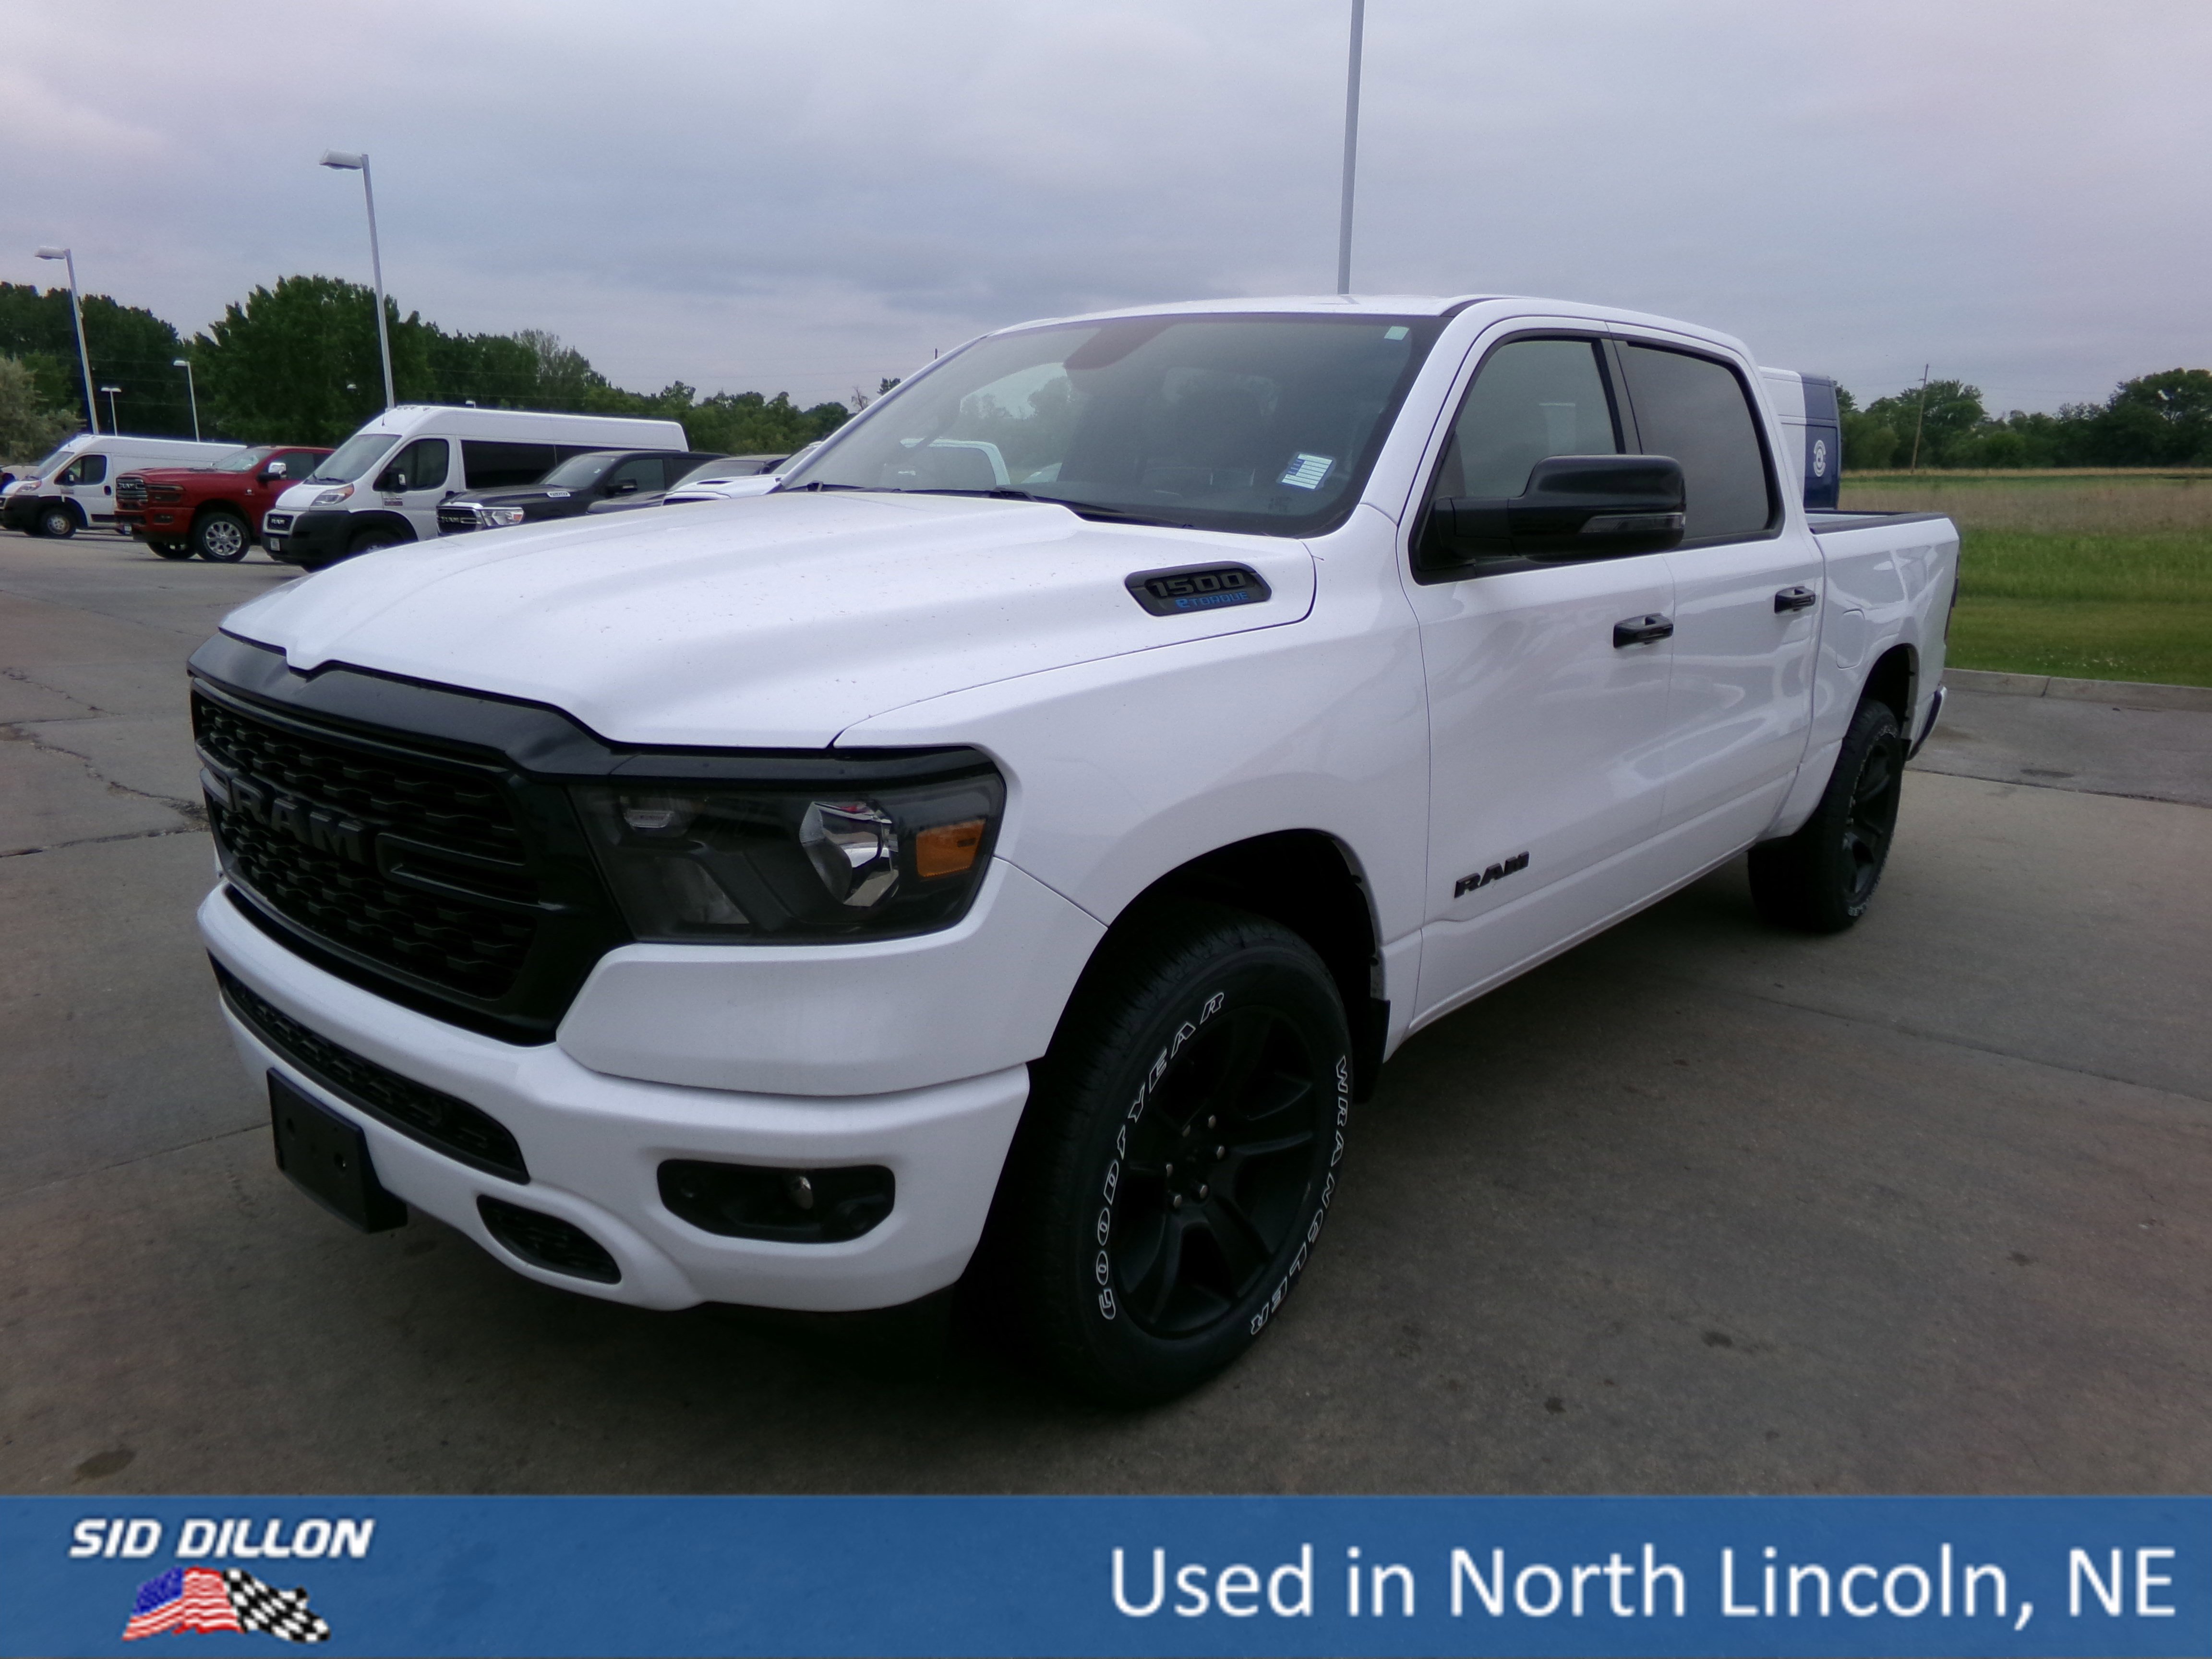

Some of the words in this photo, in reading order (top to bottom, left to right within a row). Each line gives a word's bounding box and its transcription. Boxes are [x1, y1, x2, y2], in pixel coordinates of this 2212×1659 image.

[1152, 572, 1247, 597] 1500
[231, 778, 363, 866] RAM
[1454, 851, 1530, 899] RAM
[1096, 991, 1225, 1320] GOODYEAR
[1250, 1055, 1349, 1335] WRANGLER
